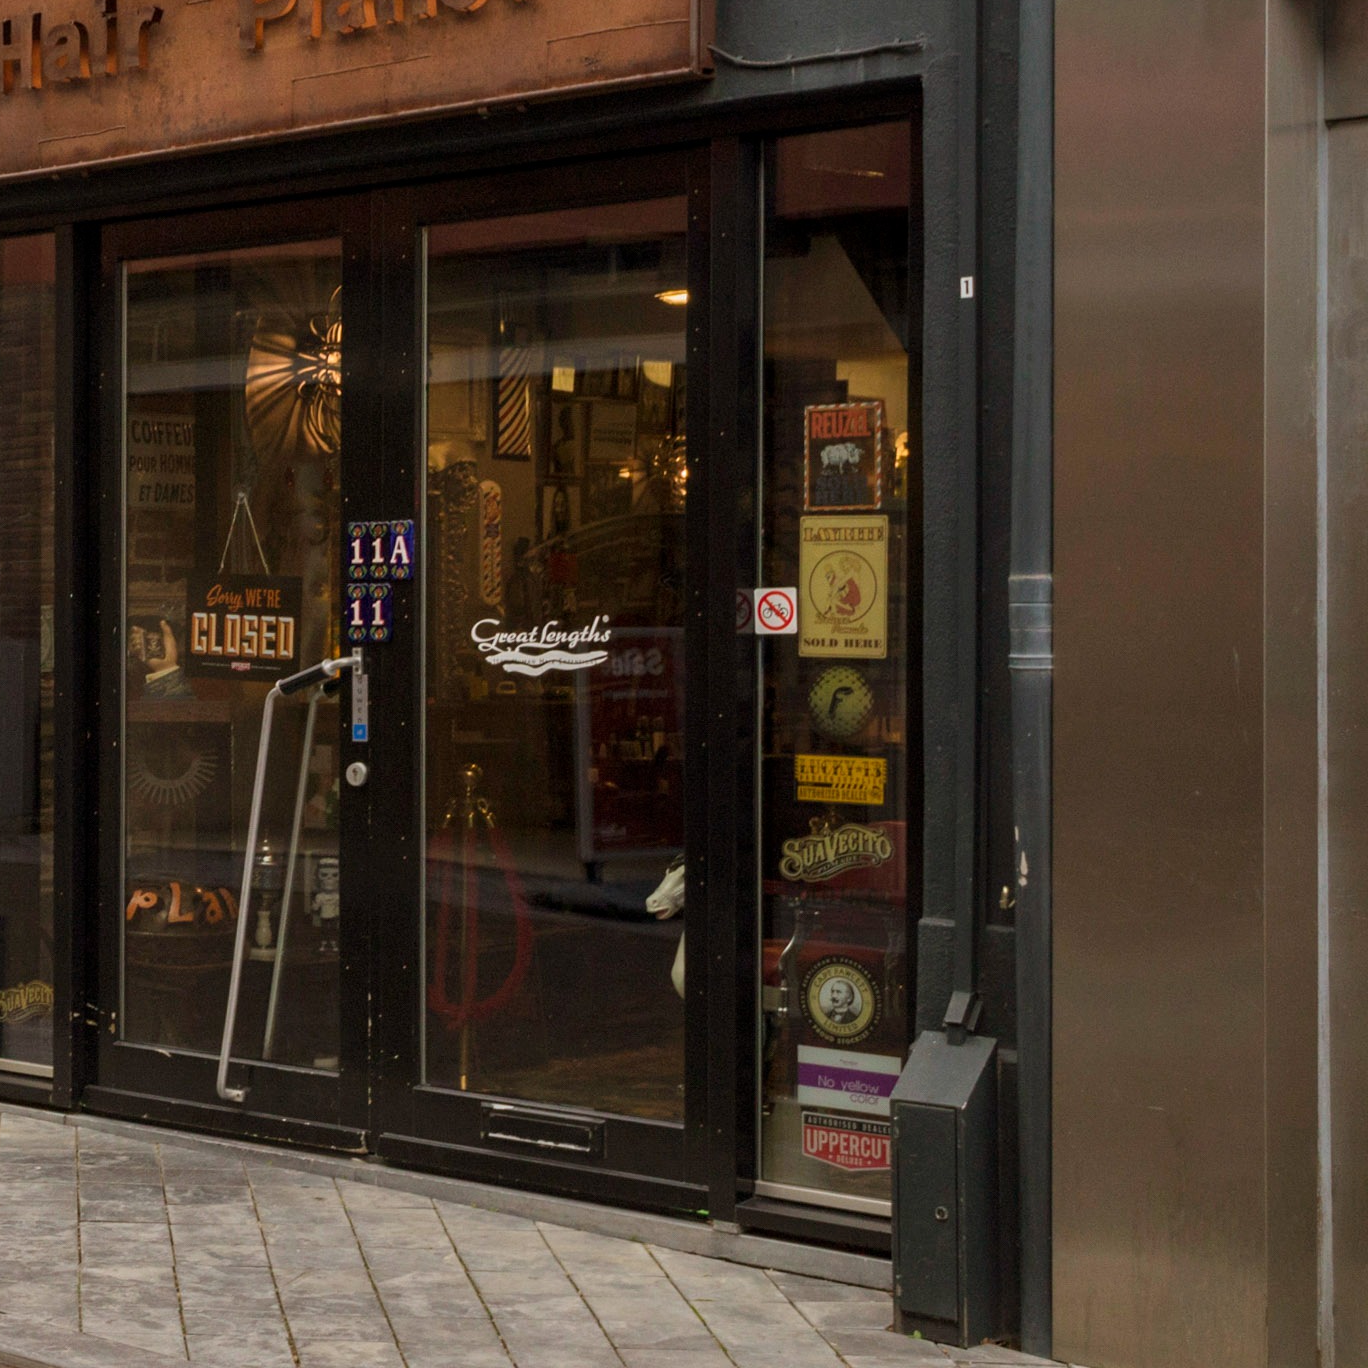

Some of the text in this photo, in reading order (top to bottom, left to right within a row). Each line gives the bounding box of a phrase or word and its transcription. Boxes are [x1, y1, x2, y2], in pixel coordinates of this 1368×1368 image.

[130, 419, 194, 446] COIFFEU
[811, 409, 872, 439] REUZEL
[154, 482, 194, 503] DAMES
[350, 535, 410, 564] 11A
[245, 588, 282, 608] WE'RE
[350, 599, 385, 626] 11
[191, 612, 295, 660] CLOSED
[471, 618, 539, 652] Great
[803, 638, 883, 649] SOLD HERE
[817, 1074, 880, 1095] No yellow
[849, 1093, 880, 1105] color
[807, 1116, 891, 1135] AUTHORISED DEALE
[806, 1129, 891, 1166] UPPERCUT
[836, 1154, 863, 1166] DELUXE
